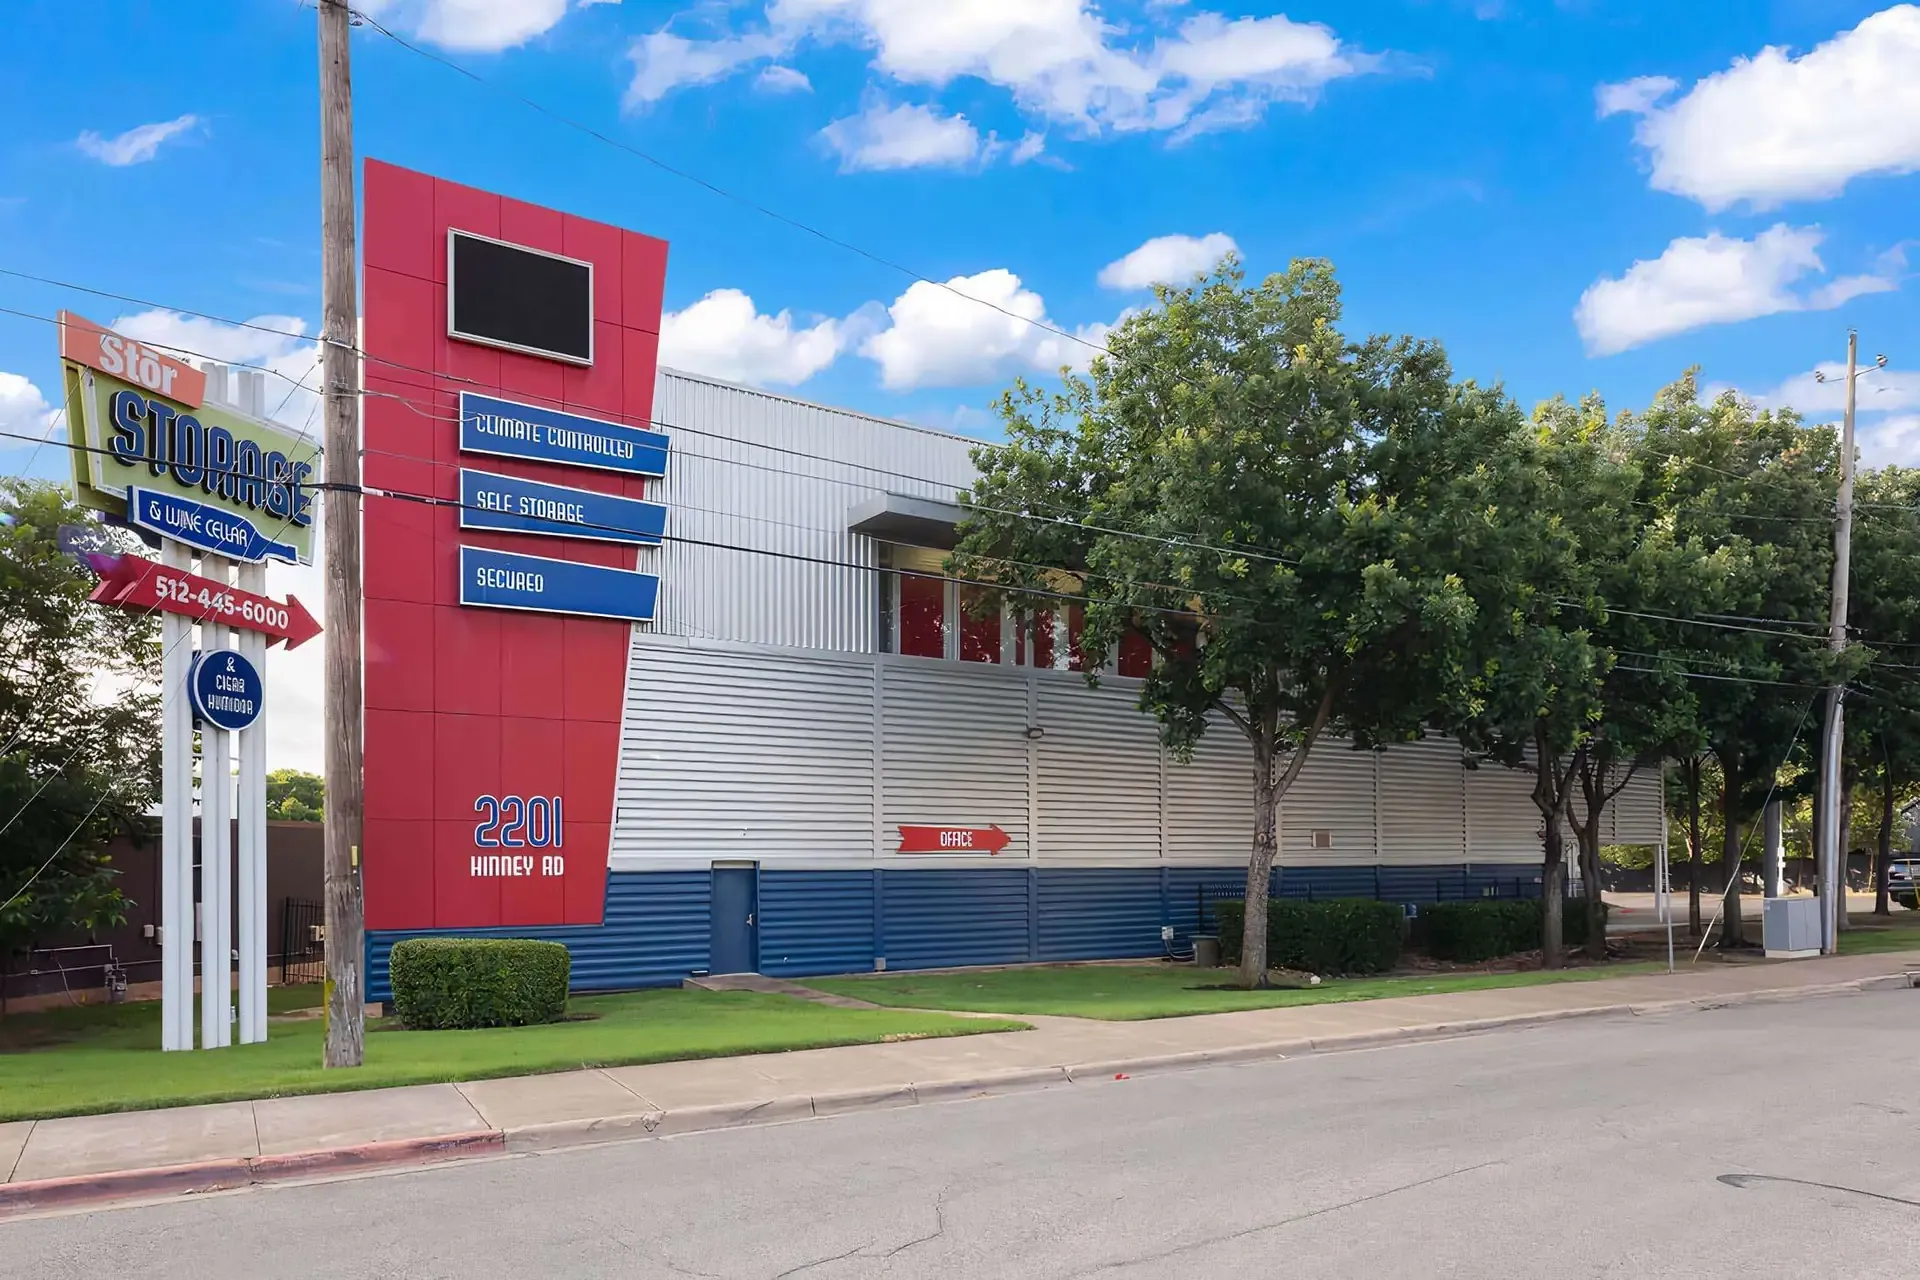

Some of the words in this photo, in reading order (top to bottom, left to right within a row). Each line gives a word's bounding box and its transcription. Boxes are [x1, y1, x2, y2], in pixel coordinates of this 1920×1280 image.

[476, 412, 541, 443] CLIMATE
[547, 426, 634, 460] CONTROLLED
[108, 390, 313, 528] STORAGE
[149, 501, 162, 521] &
[165, 505, 202, 534] WINE
[205, 518, 248, 547] CELLAR
[477, 490, 513, 512] SELF
[519, 496, 585, 524] STORAGE
[477, 567, 544, 593] SECURED
[155, 574, 290, 630] 512-445-6000
[215, 674, 245, 693] CIGAR
[226, 656, 236, 672] &
[474, 794, 563, 848] 2201
[940, 831, 973, 847] OFFICE
